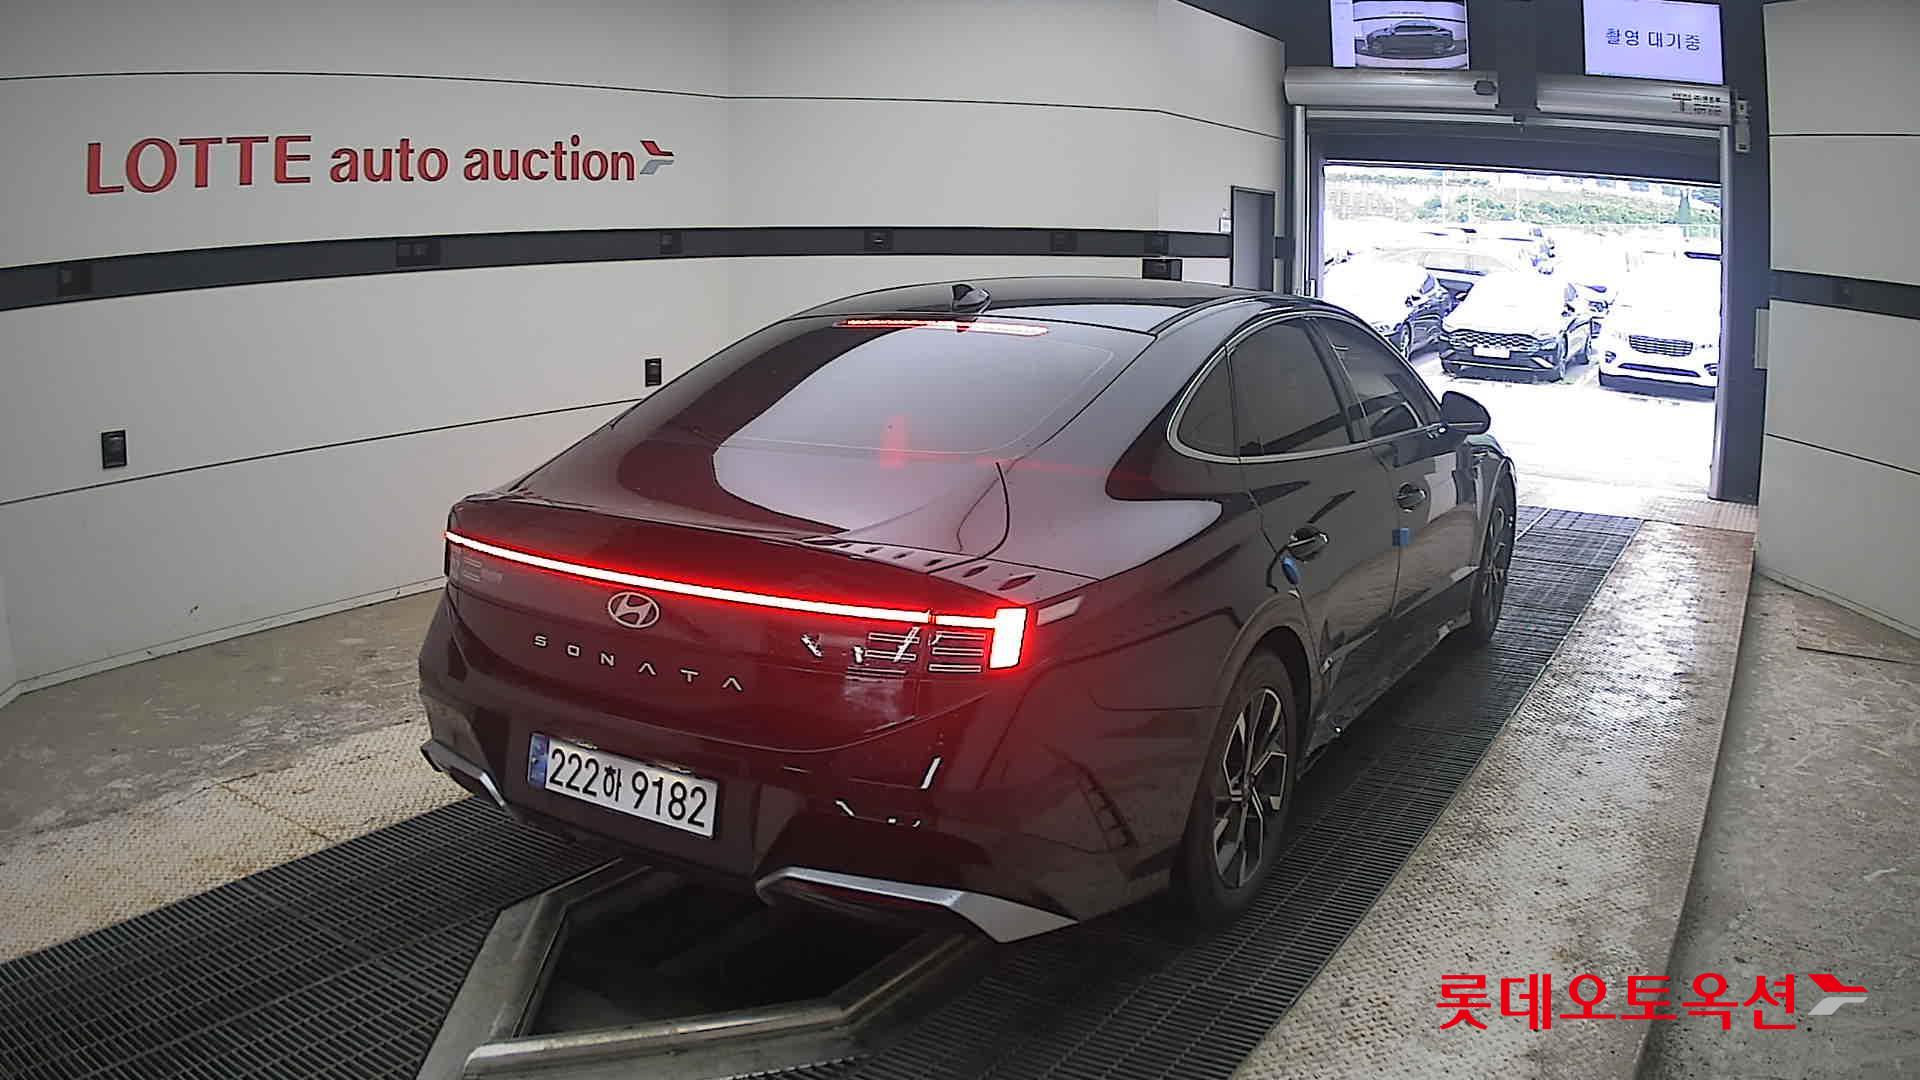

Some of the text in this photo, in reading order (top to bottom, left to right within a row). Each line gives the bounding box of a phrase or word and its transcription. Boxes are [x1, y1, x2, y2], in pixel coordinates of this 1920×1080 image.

[1648, 31, 1701, 51] 대기중
[86, 134, 636, 195] LOTTE auto auction
[533, 634, 744, 692] SONATA
[548, 747, 708, 828] 222하 9182
